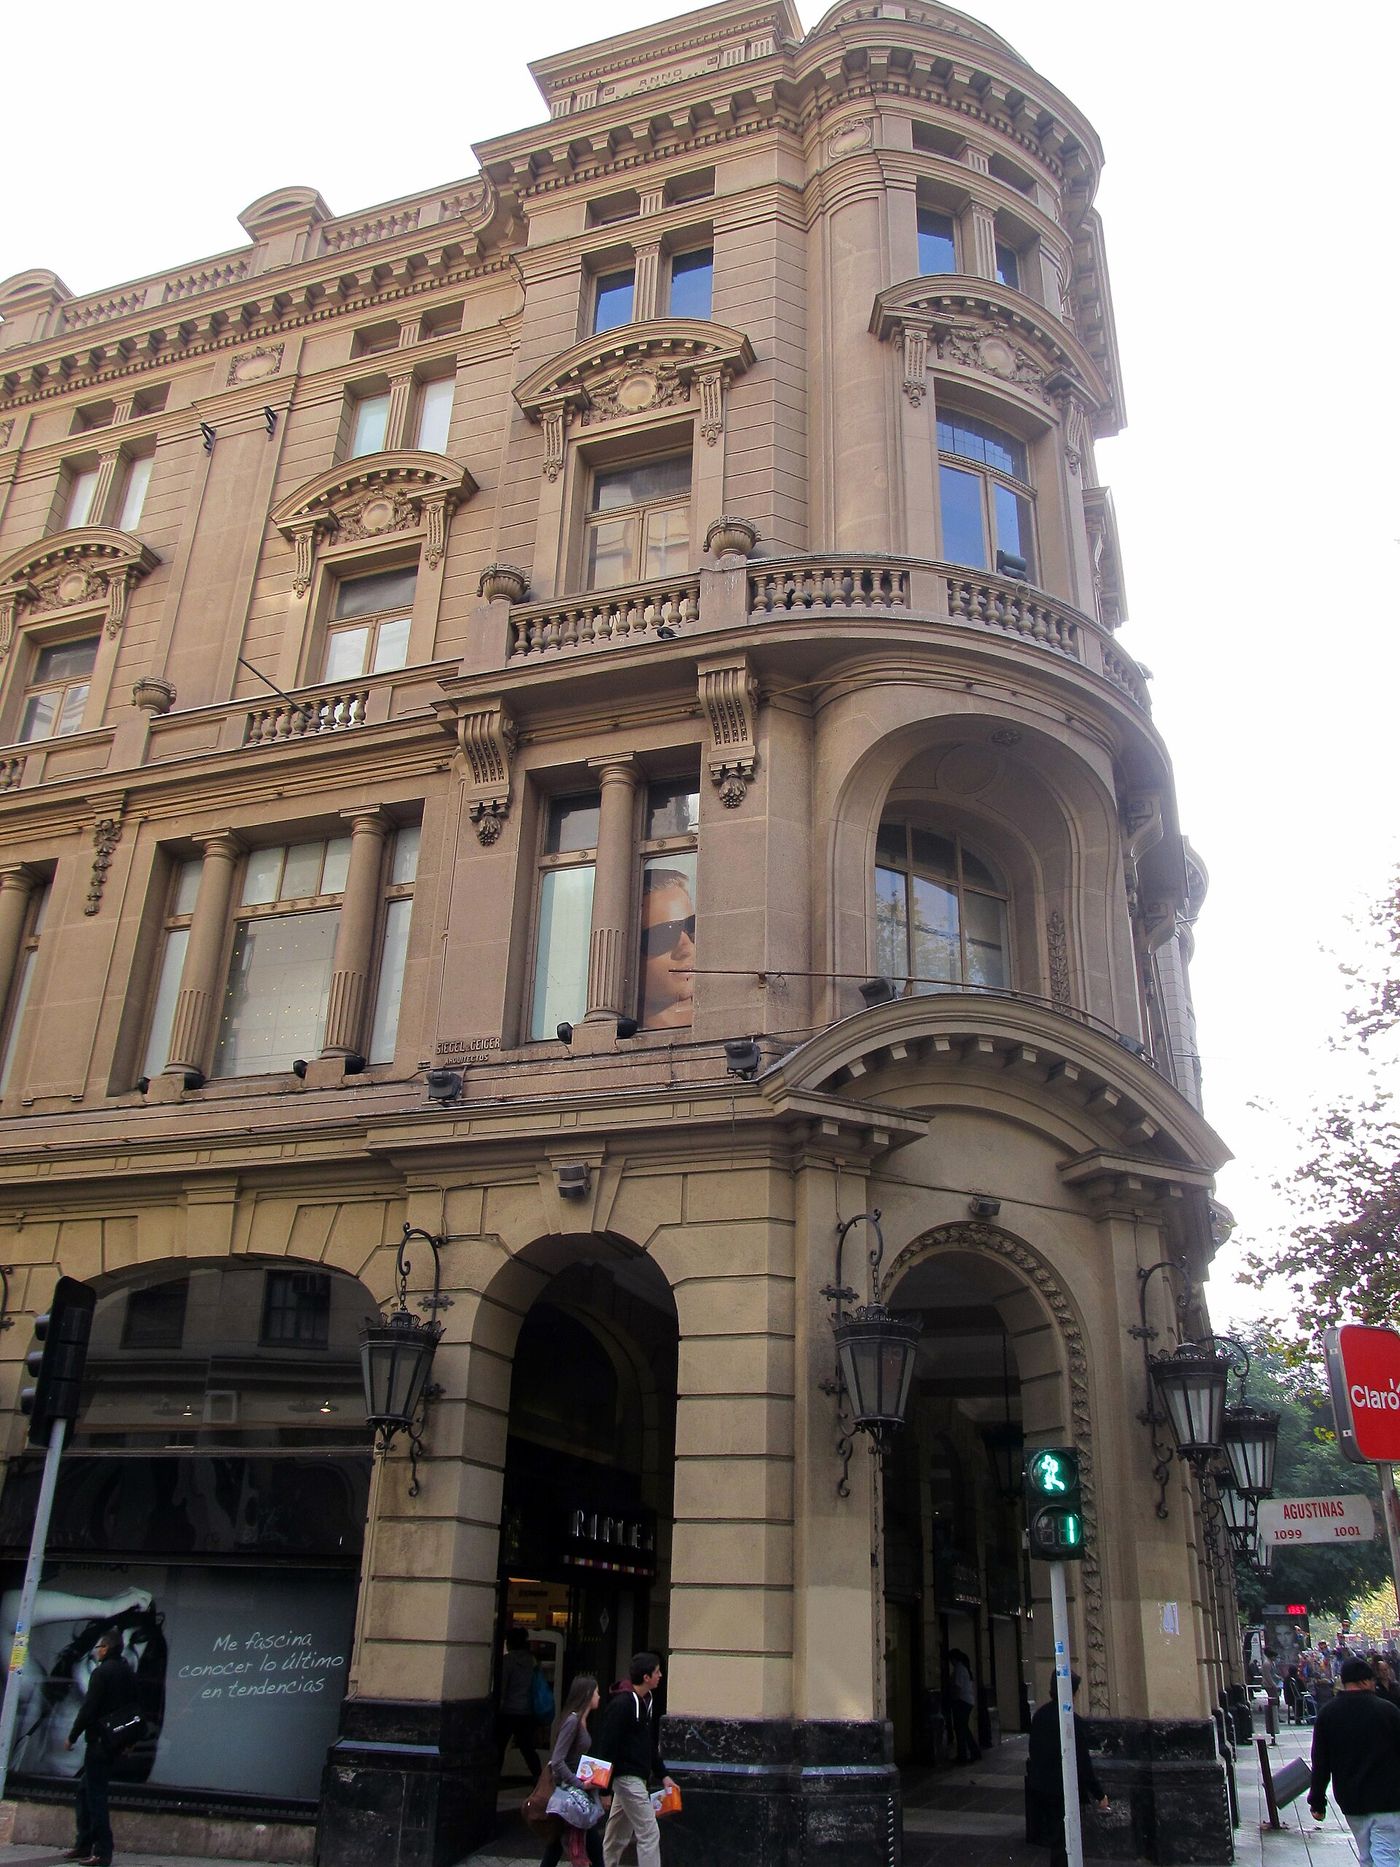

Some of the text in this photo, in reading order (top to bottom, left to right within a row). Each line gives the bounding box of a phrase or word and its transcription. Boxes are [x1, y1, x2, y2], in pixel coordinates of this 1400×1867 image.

[639, 68, 682, 87] ANNO
[1283, 1501, 1345, 1520] AGUSTINAS
[1274, 1526, 1361, 1540] 1099 1001
[212, 1630, 312, 1651] Me fascina
[178, 1651, 345, 1678] conocer lo último
[201, 1675, 326, 1699] en tendencias
